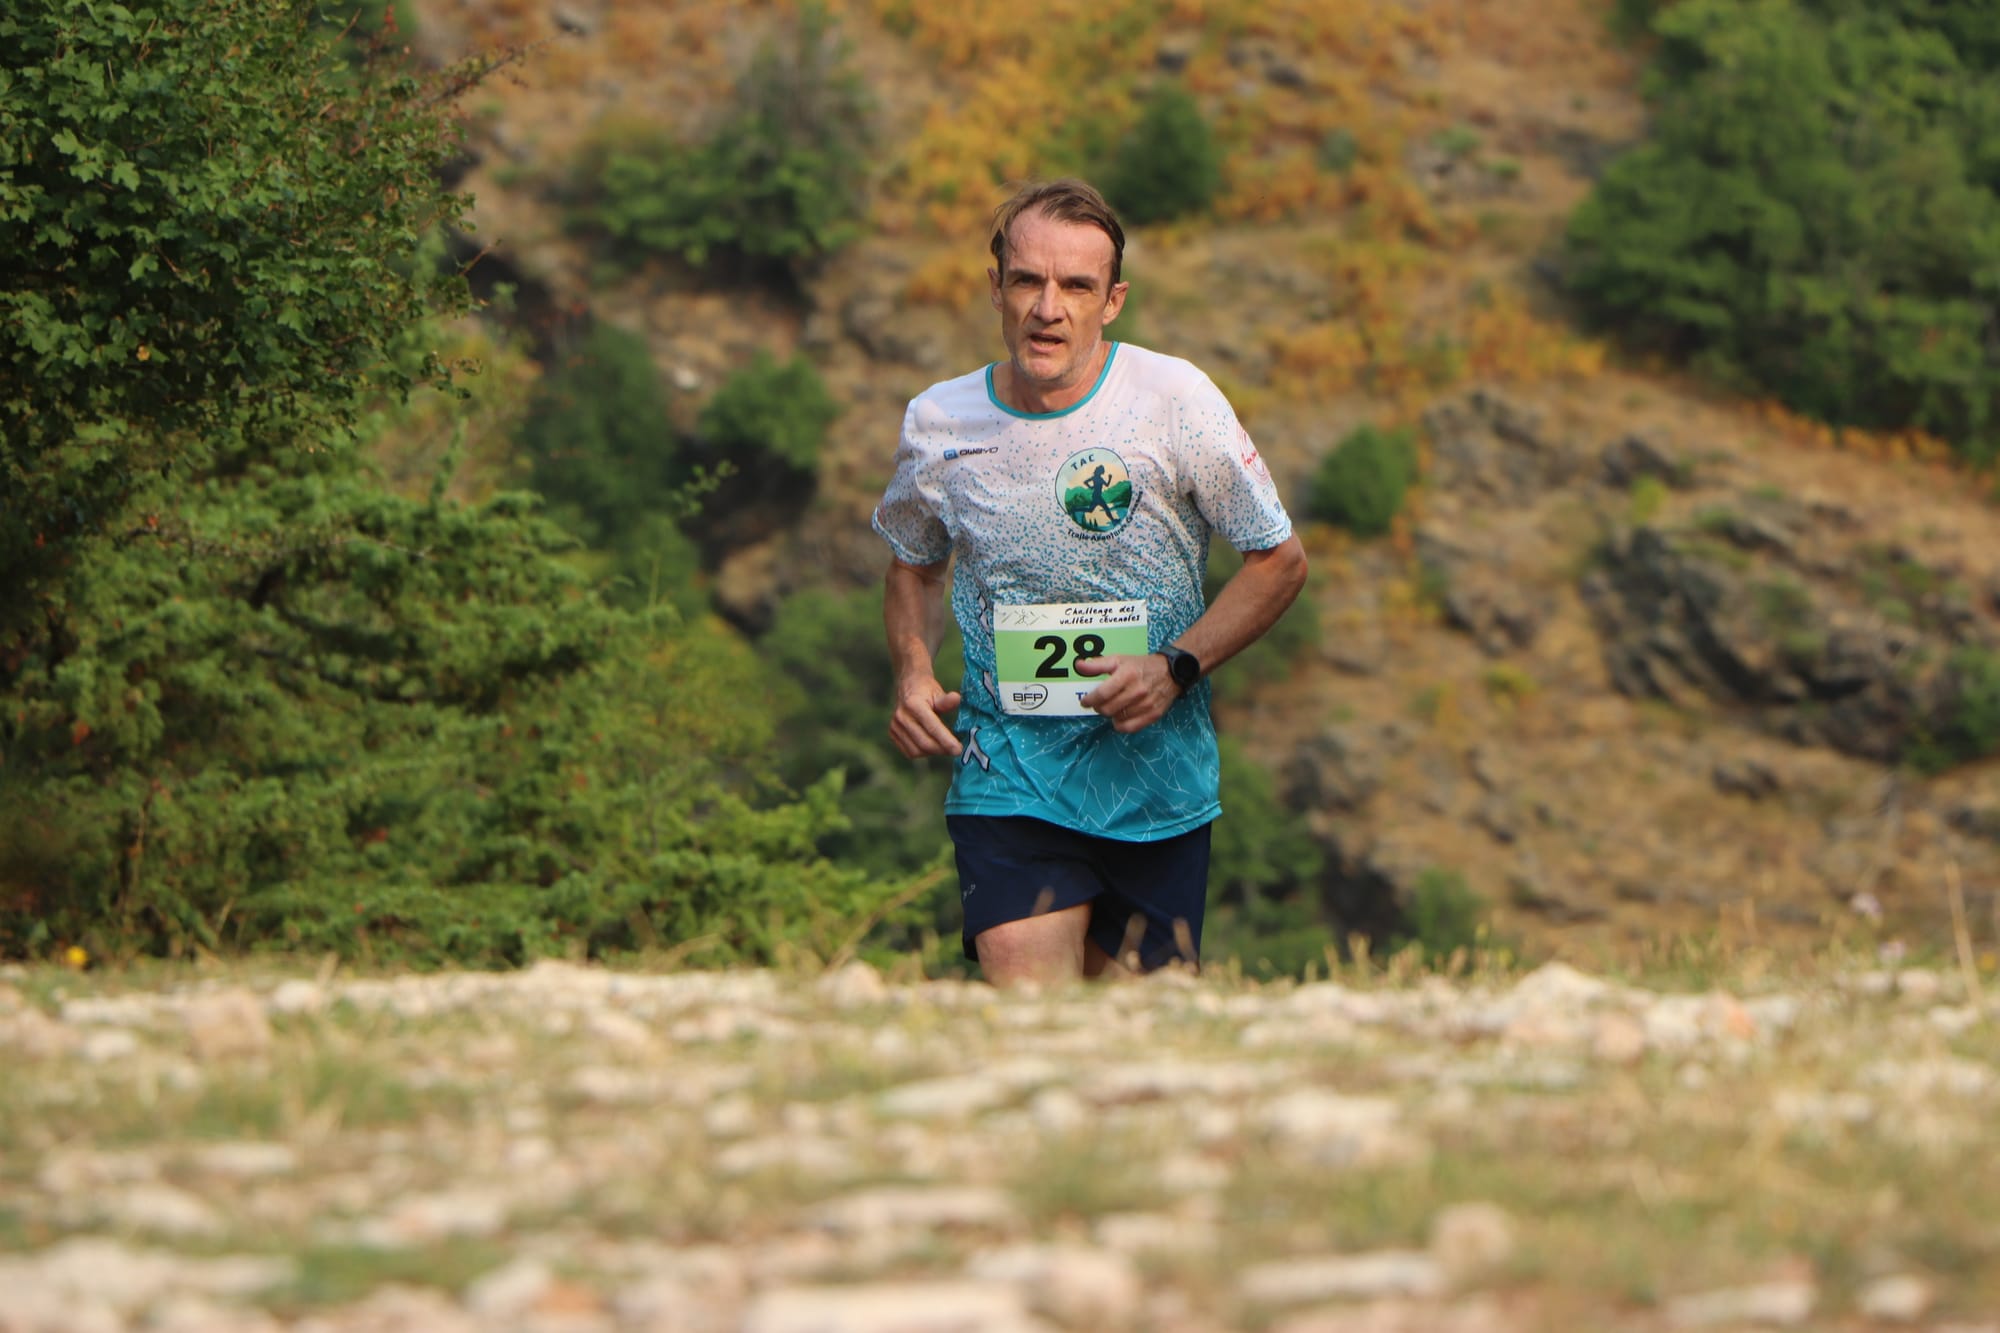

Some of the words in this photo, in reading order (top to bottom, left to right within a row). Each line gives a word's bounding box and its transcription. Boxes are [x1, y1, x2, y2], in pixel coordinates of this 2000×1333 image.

[1071, 454, 1095, 471] TAC
[1065, 606, 1113, 617] Challenge
[1119, 605, 1135, 614] des
[1059, 615, 1093, 625] vallées
[1099, 614, 1141, 624] cévenoles
[1034, 634, 1105, 679] 28
[1013, 692, 1043, 702] BFP
